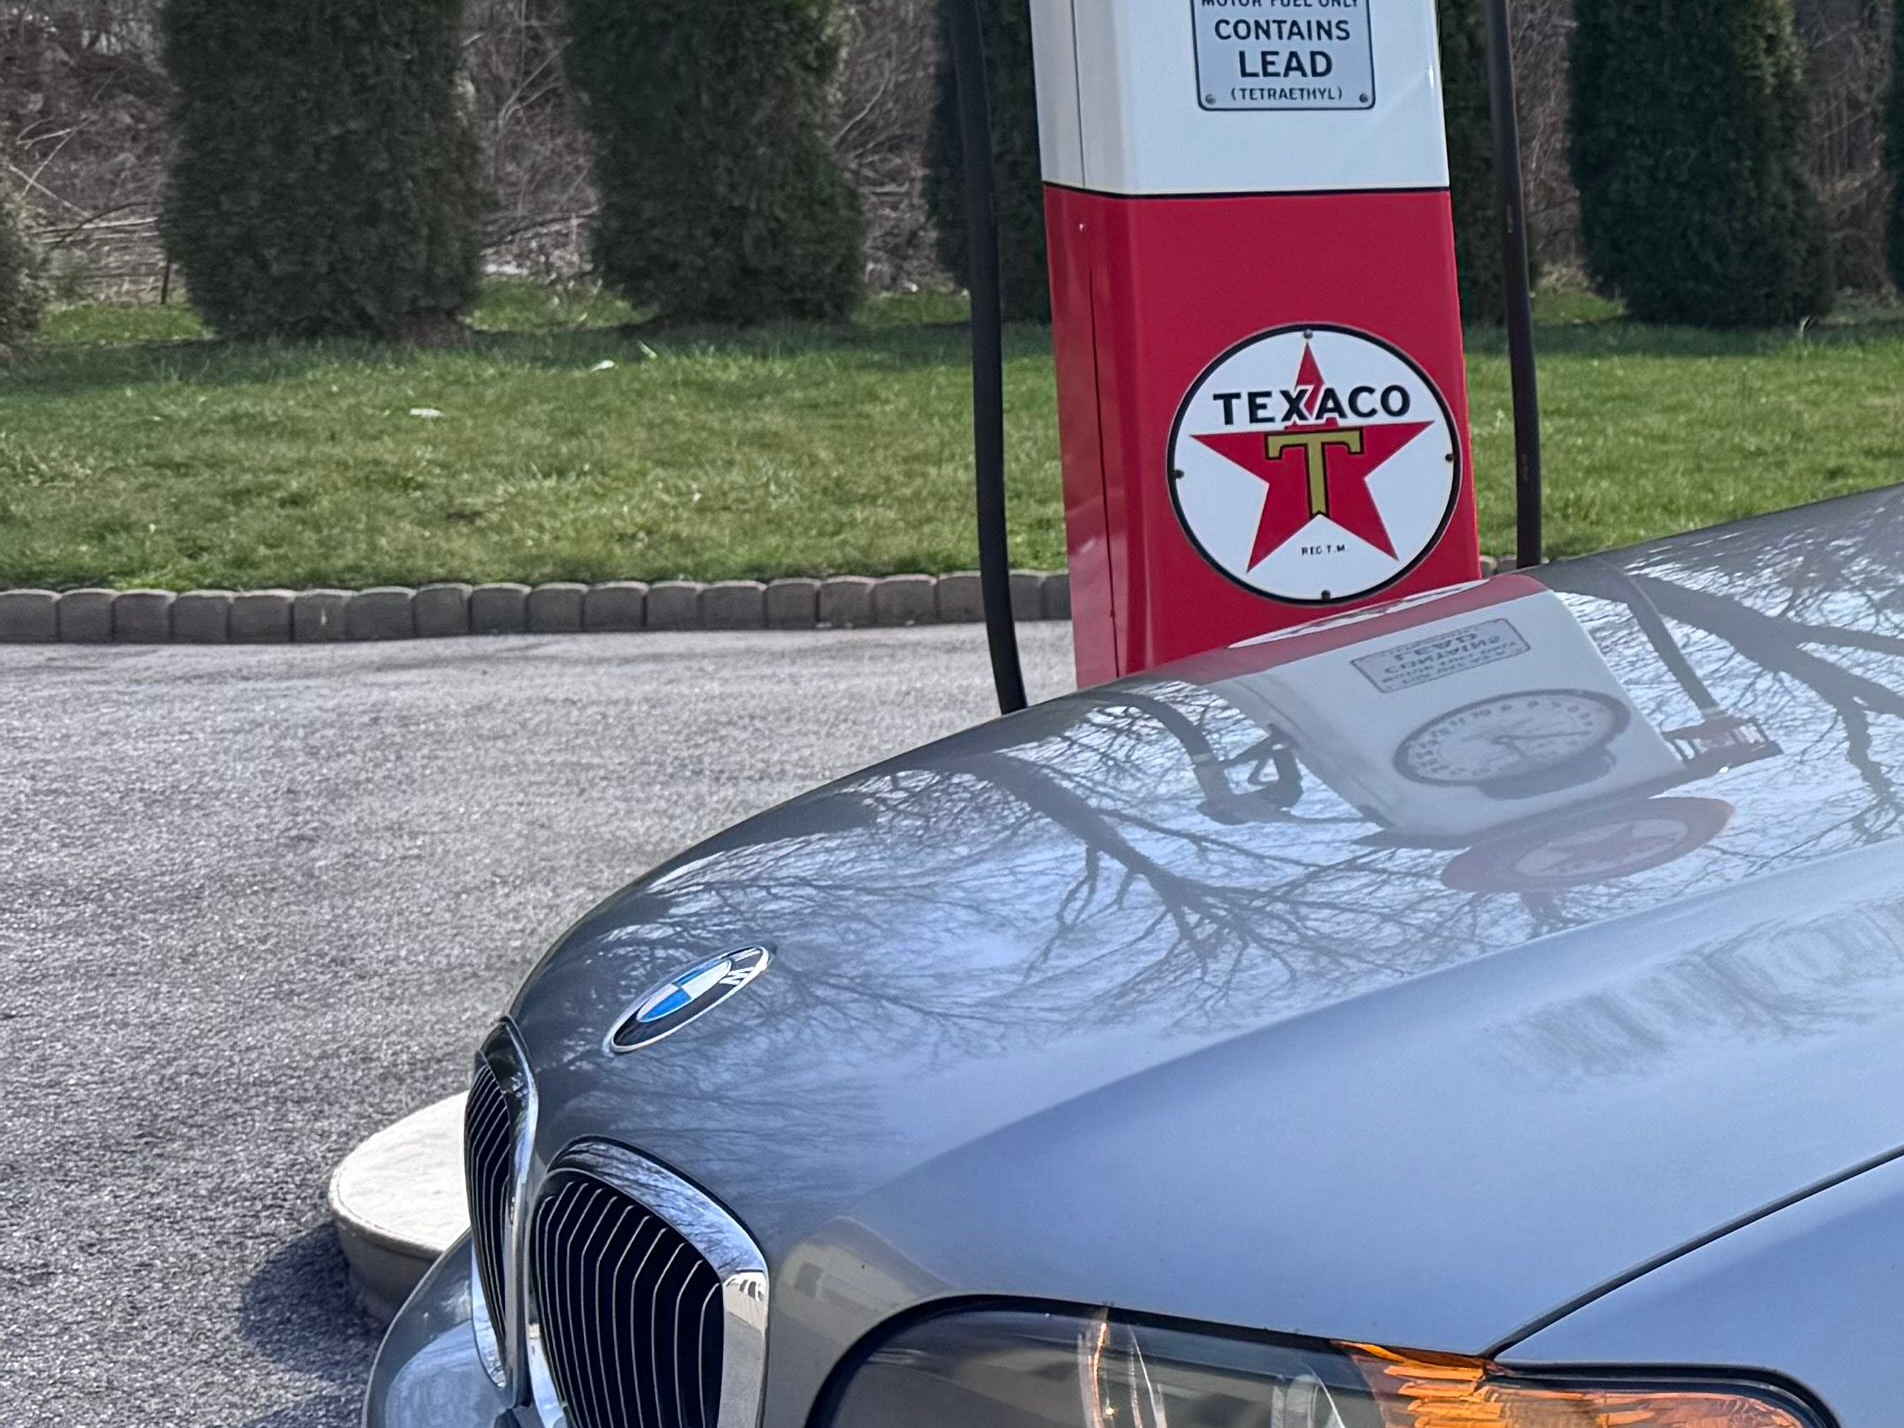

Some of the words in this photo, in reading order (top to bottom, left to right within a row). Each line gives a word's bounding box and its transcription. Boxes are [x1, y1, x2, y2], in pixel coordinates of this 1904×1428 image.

[1214, 18, 1351, 41] CONTAINS
[1238, 50, 1333, 78] LEAD
[1230, 87, 1343, 101] (TETRAETHYL)
[1212, 384, 1411, 426] TEXACO
[1265, 427, 1365, 520] T
